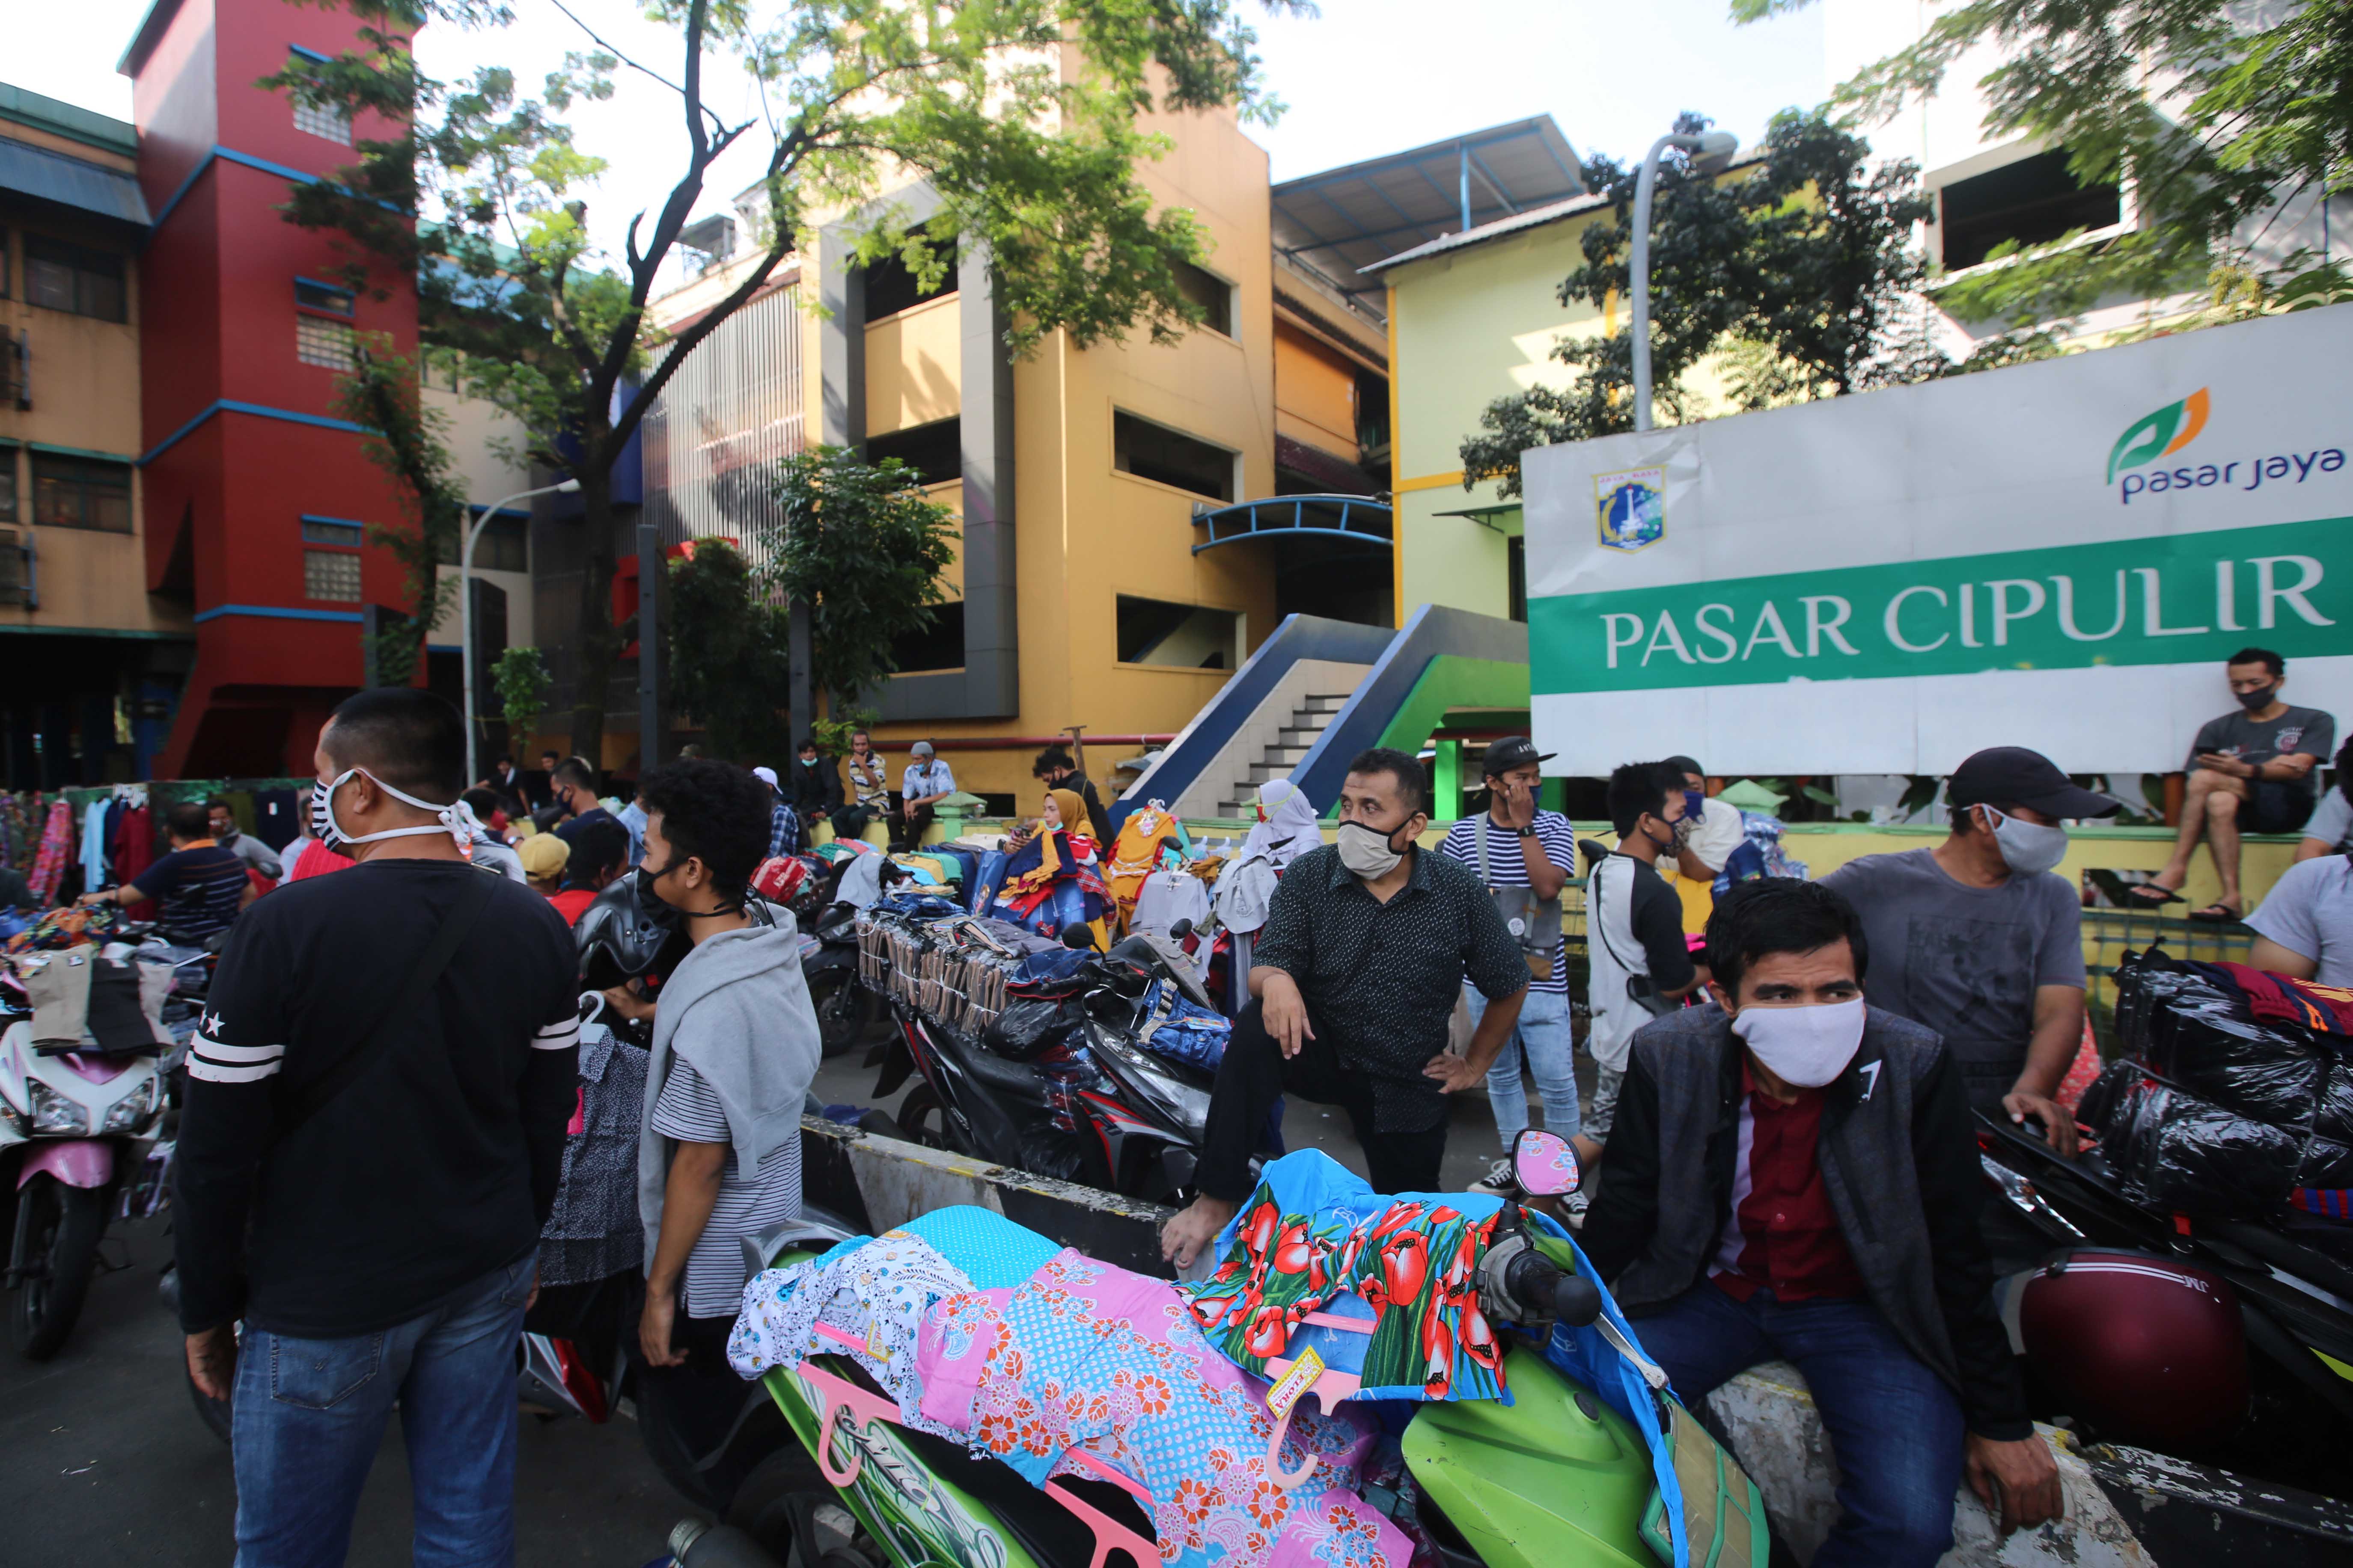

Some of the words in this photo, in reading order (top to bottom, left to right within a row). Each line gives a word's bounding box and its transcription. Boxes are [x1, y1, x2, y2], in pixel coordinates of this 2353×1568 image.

[2122, 461, 2241, 504] pasar
[2243, 448, 2345, 490] jaya
[1599, 595, 1860, 668] PASAR
[1884, 555, 2336, 653] CIPULIR
[1275, 1374, 1305, 1409] ELORA
